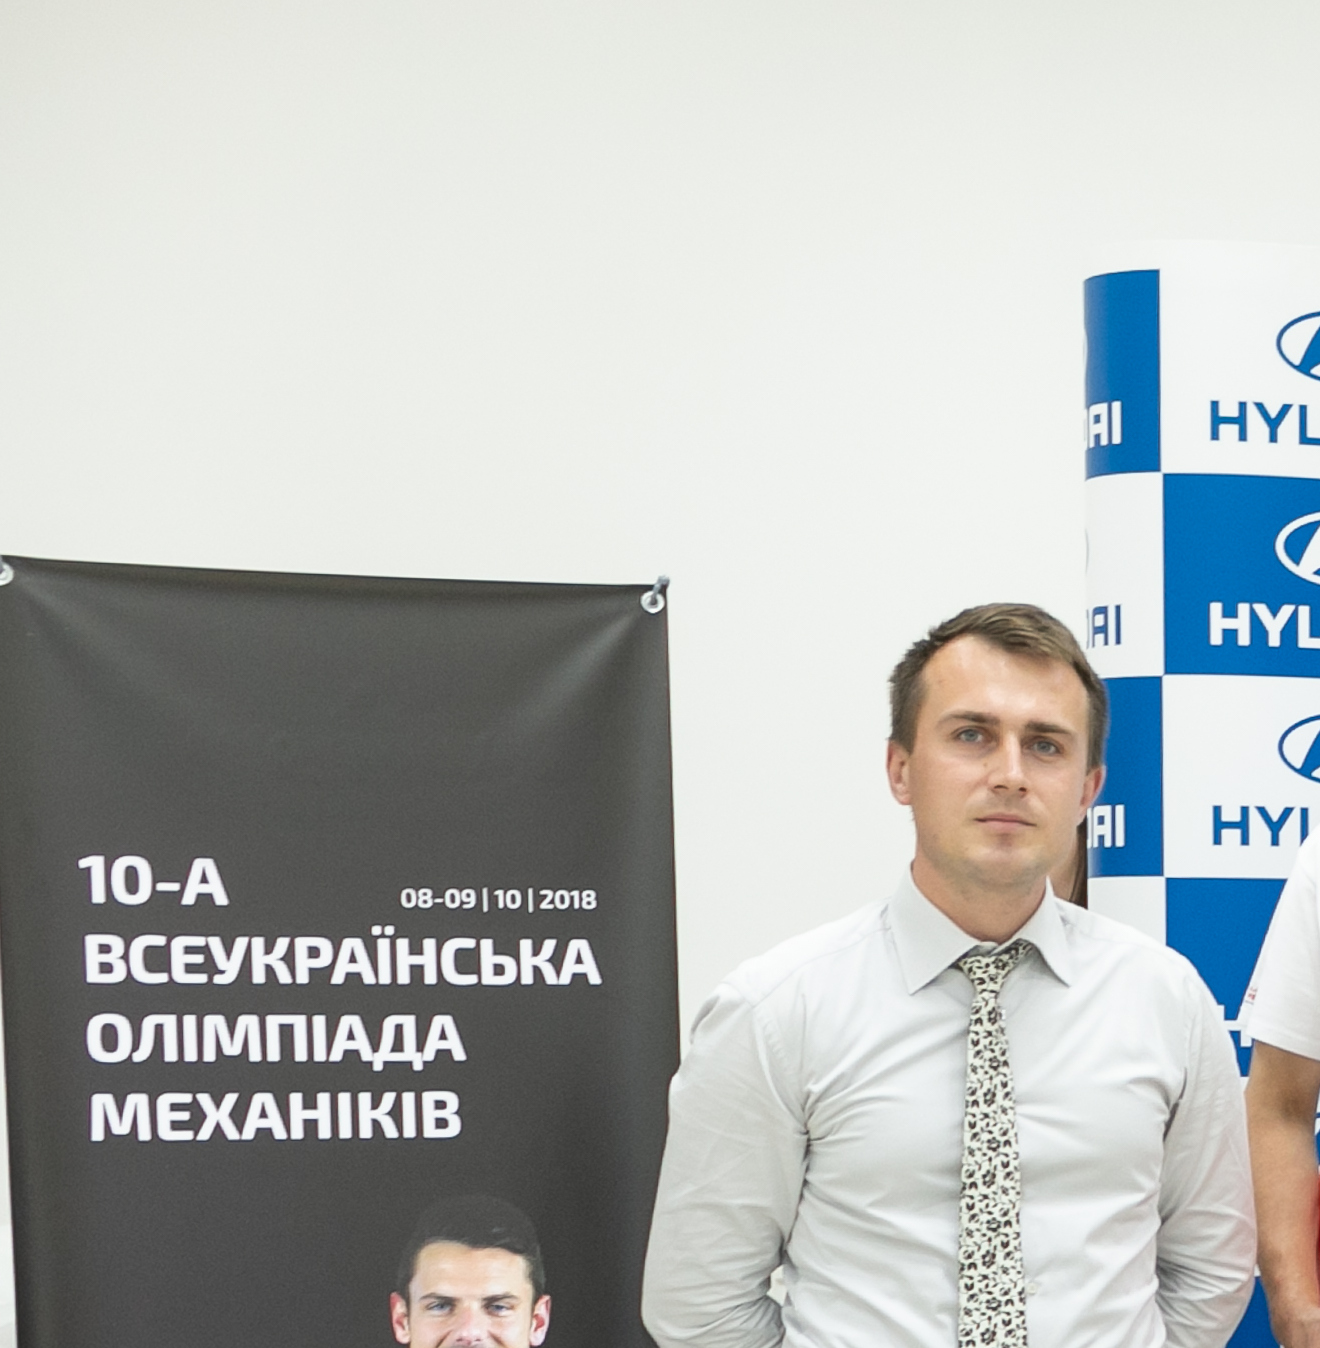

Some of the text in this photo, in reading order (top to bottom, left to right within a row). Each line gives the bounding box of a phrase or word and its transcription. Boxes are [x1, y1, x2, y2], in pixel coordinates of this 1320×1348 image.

[78, 855, 229, 906] 10-А
[83, 924, 603, 986] ВСЕУКРАЇНСЬКА
[85, 1013, 468, 1072] ОЛІМПІАДА
[89, 1089, 463, 1142] МЕХАНІКІВ
